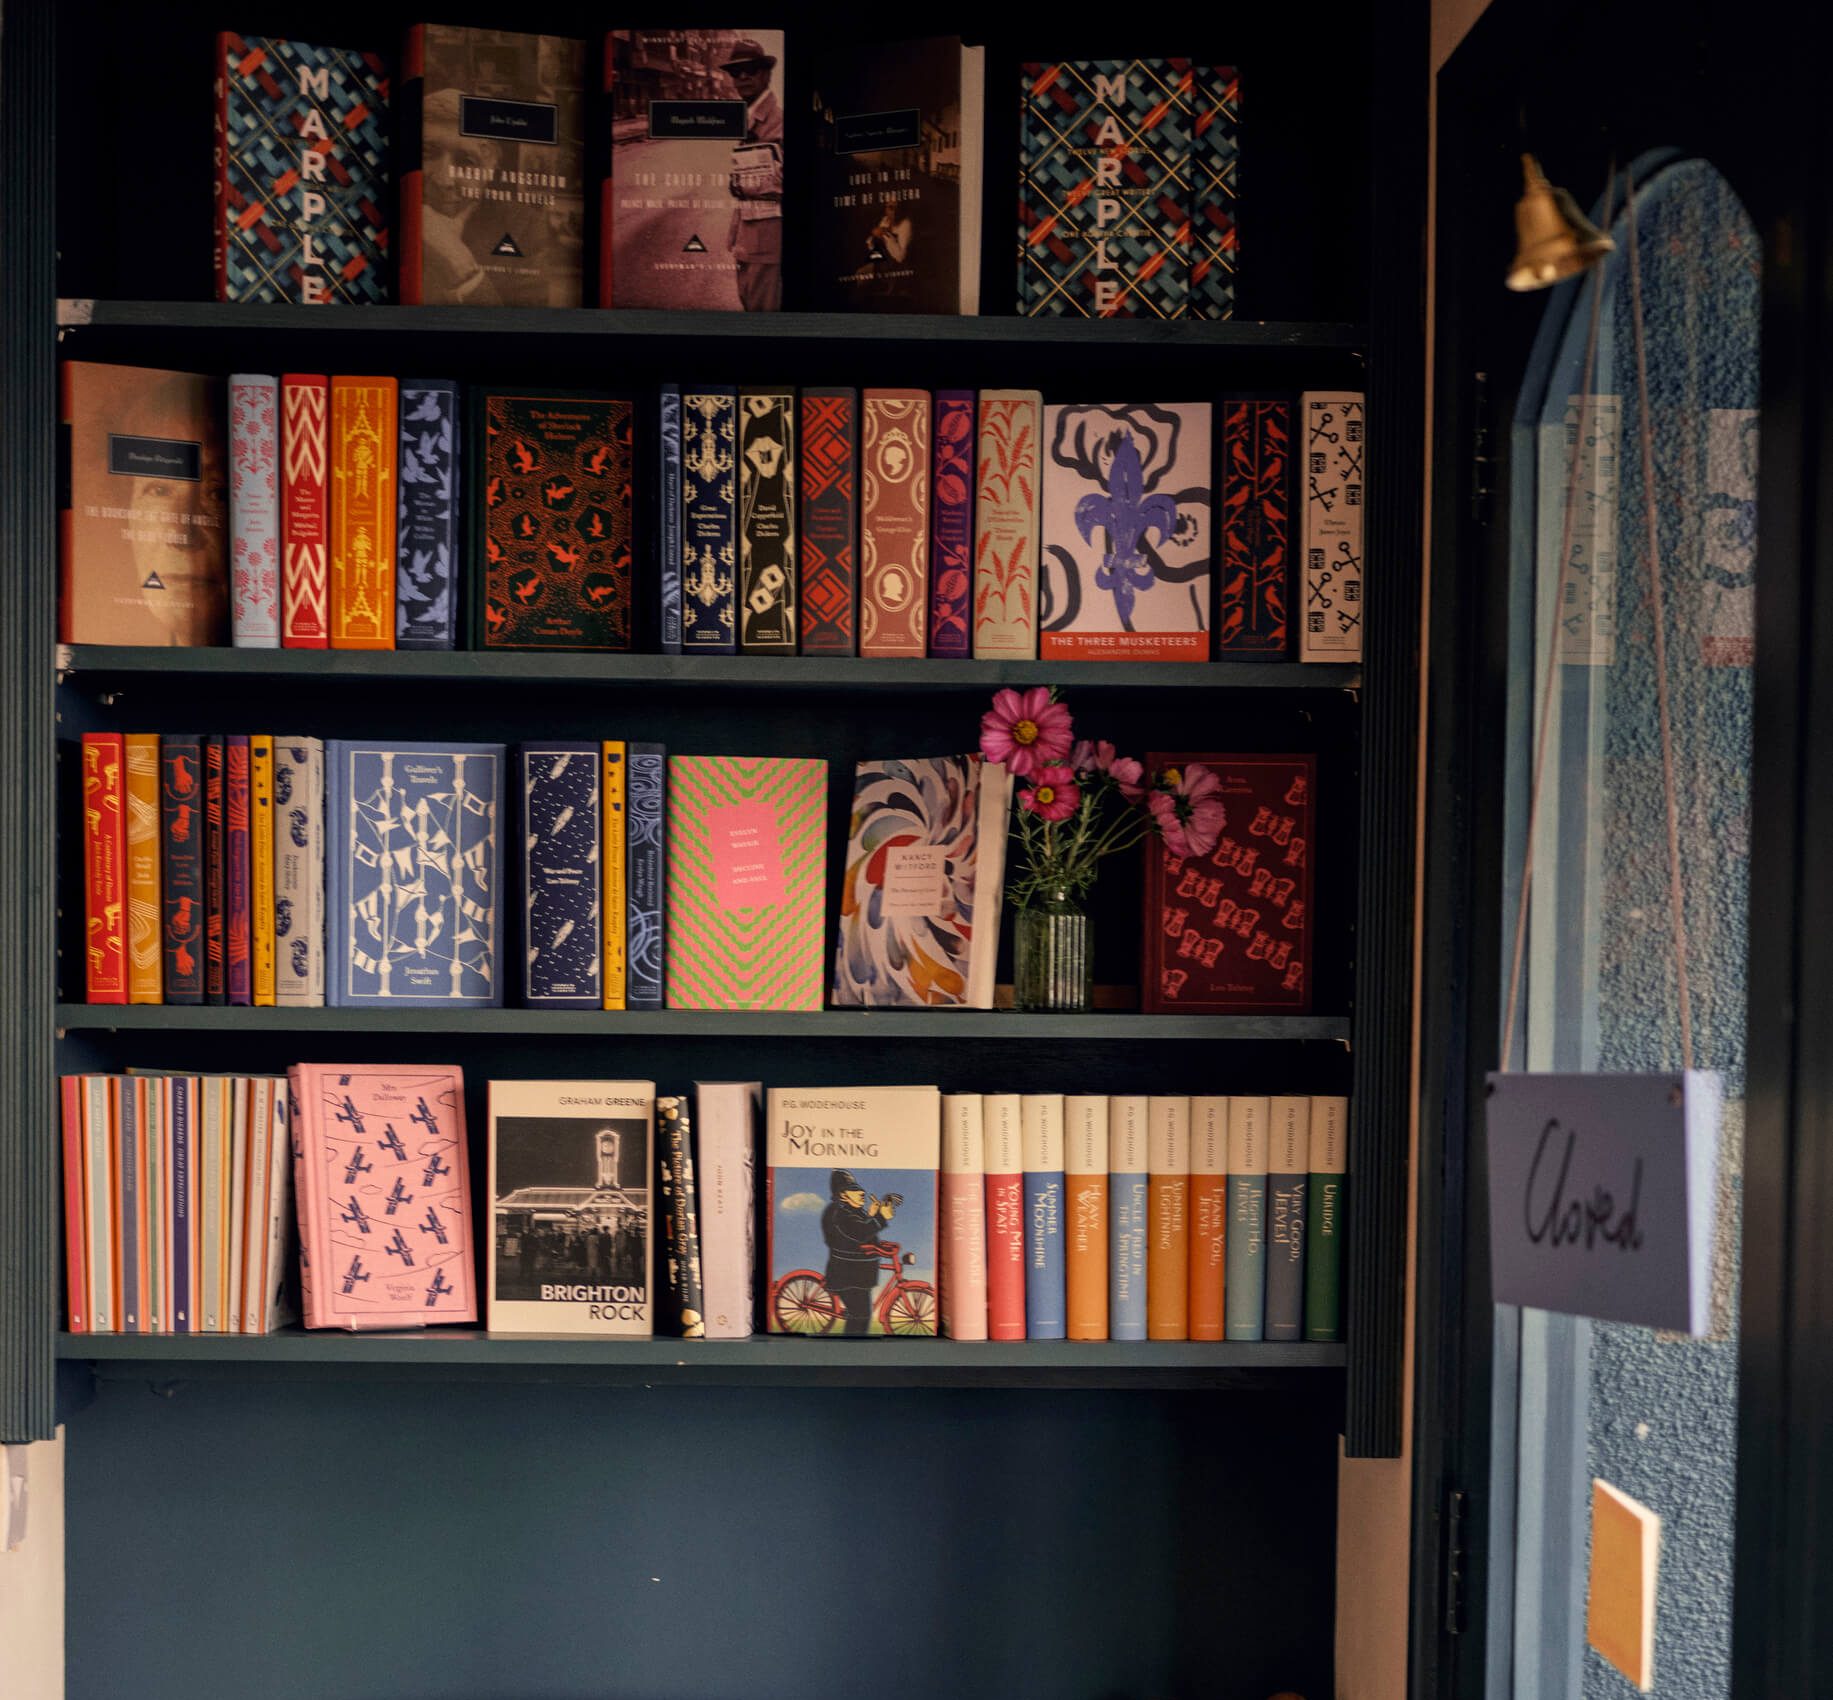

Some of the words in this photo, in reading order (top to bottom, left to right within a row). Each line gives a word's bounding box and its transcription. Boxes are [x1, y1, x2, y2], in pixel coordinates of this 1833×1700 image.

[294, 65, 329, 304] MARPLE
[1094, 74, 1127, 310] MARPLE
[1050, 636, 1073, 646] THE
[1078, 636, 1115, 646] THREE
[1120, 636, 1198, 646] MUSKETEERS
[559, 1096, 601, 1105] GRAHAM
[605, 1097, 646, 1106] GREENE
[800, 1100, 866, 1110] WODEHOUSE
[782, 1120, 816, 1138] JOY
[822, 1128, 834, 1137] IN
[840, 1128, 864, 1138] THE
[788, 1138, 879, 1157] MORNING
[998, 1187, 1005, 1196] IN
[1133, 1184, 1144, 1223] UNCLE
[1237, 1181, 1250, 1222] JEEVES
[1292, 1184, 1304, 1214] VERY
[1526, 1117, 1642, 1251] Closed
[996, 1200, 1008, 1234] SPATS
[1008, 1183, 1020, 1226] YOUNG
[1047, 1183, 1059, 1234] SUMMER
[1076, 1190, 1090, 1252] WEATHER
[1088, 1185, 1102, 1229] HEAVY
[1119, 1206, 1129, 1226] THE
[1160, 1185, 1171, 1250] LIGHTNING
[1172, 1182, 1184, 1232] SUMMER
[1199, 1196, 1212, 1237] JEEVES
[1211, 1188, 1223, 1228] THANK
[1274, 1191, 1289, 1244] JEEVES!
[1322, 1184, 1337, 1236] UKRIDGE
[1011, 1231, 1022, 1262] MEN
[1033, 1192, 1047, 1269] MOONSHINE
[1132, 1228, 1144, 1258] FRED
[1288, 1220, 1303, 1262] GOOD,
[1119, 1233, 1130, 1301] SPRINGTIME
[1132, 1264, 1143, 1275] IN
[540, 1284, 645, 1302] BRIGHTON
[590, 1304, 646, 1321] ROCK
